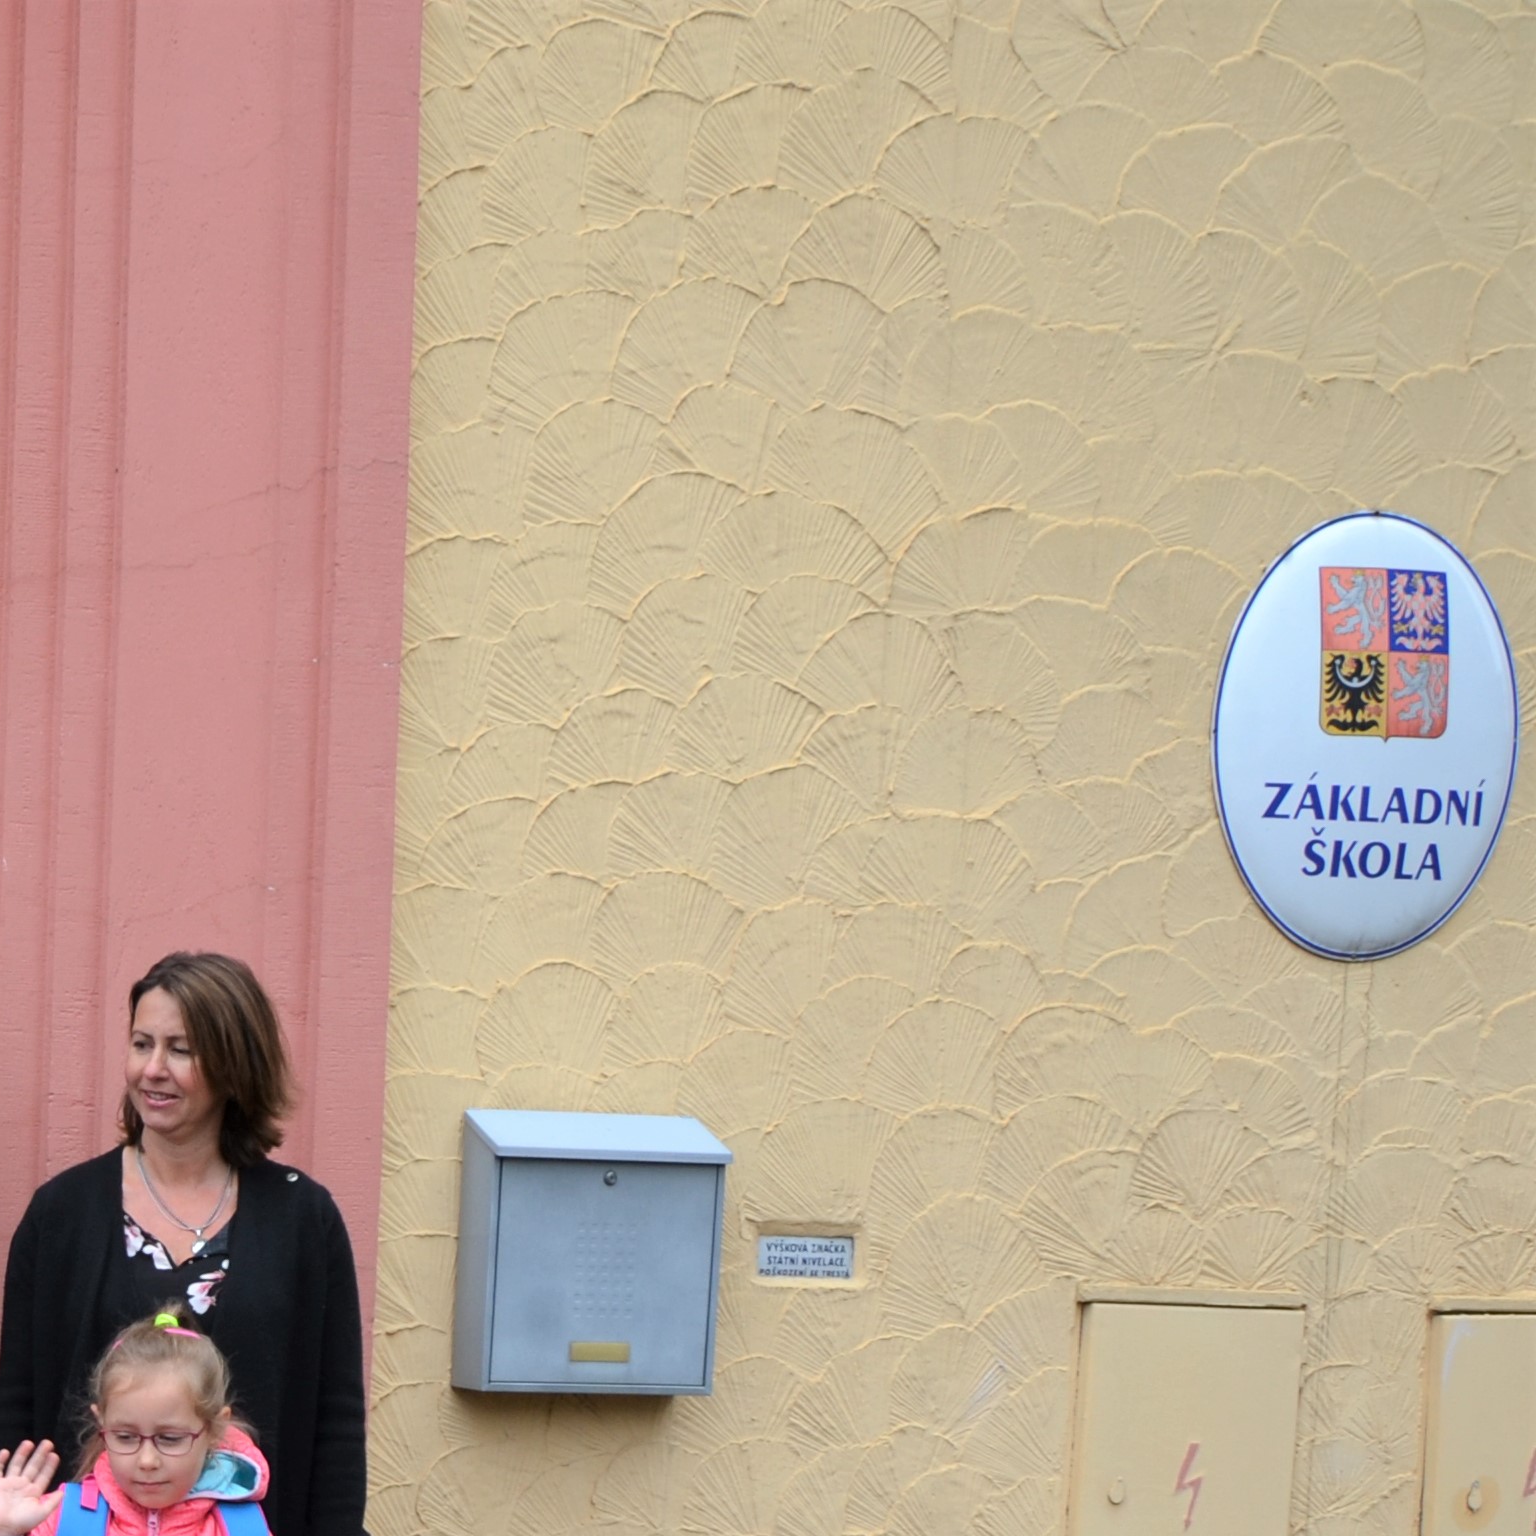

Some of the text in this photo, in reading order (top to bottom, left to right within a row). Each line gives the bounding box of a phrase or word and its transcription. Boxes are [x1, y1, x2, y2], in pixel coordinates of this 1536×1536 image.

[1261, 772, 1486, 827] ZÁKLADNÍ
[1301, 827, 1443, 881] ŠKOLA
[766, 1239, 847, 1254] VÝŠKOVÁ ZNAČKA
[767, 1254, 799, 1266] STÁTNÍ
